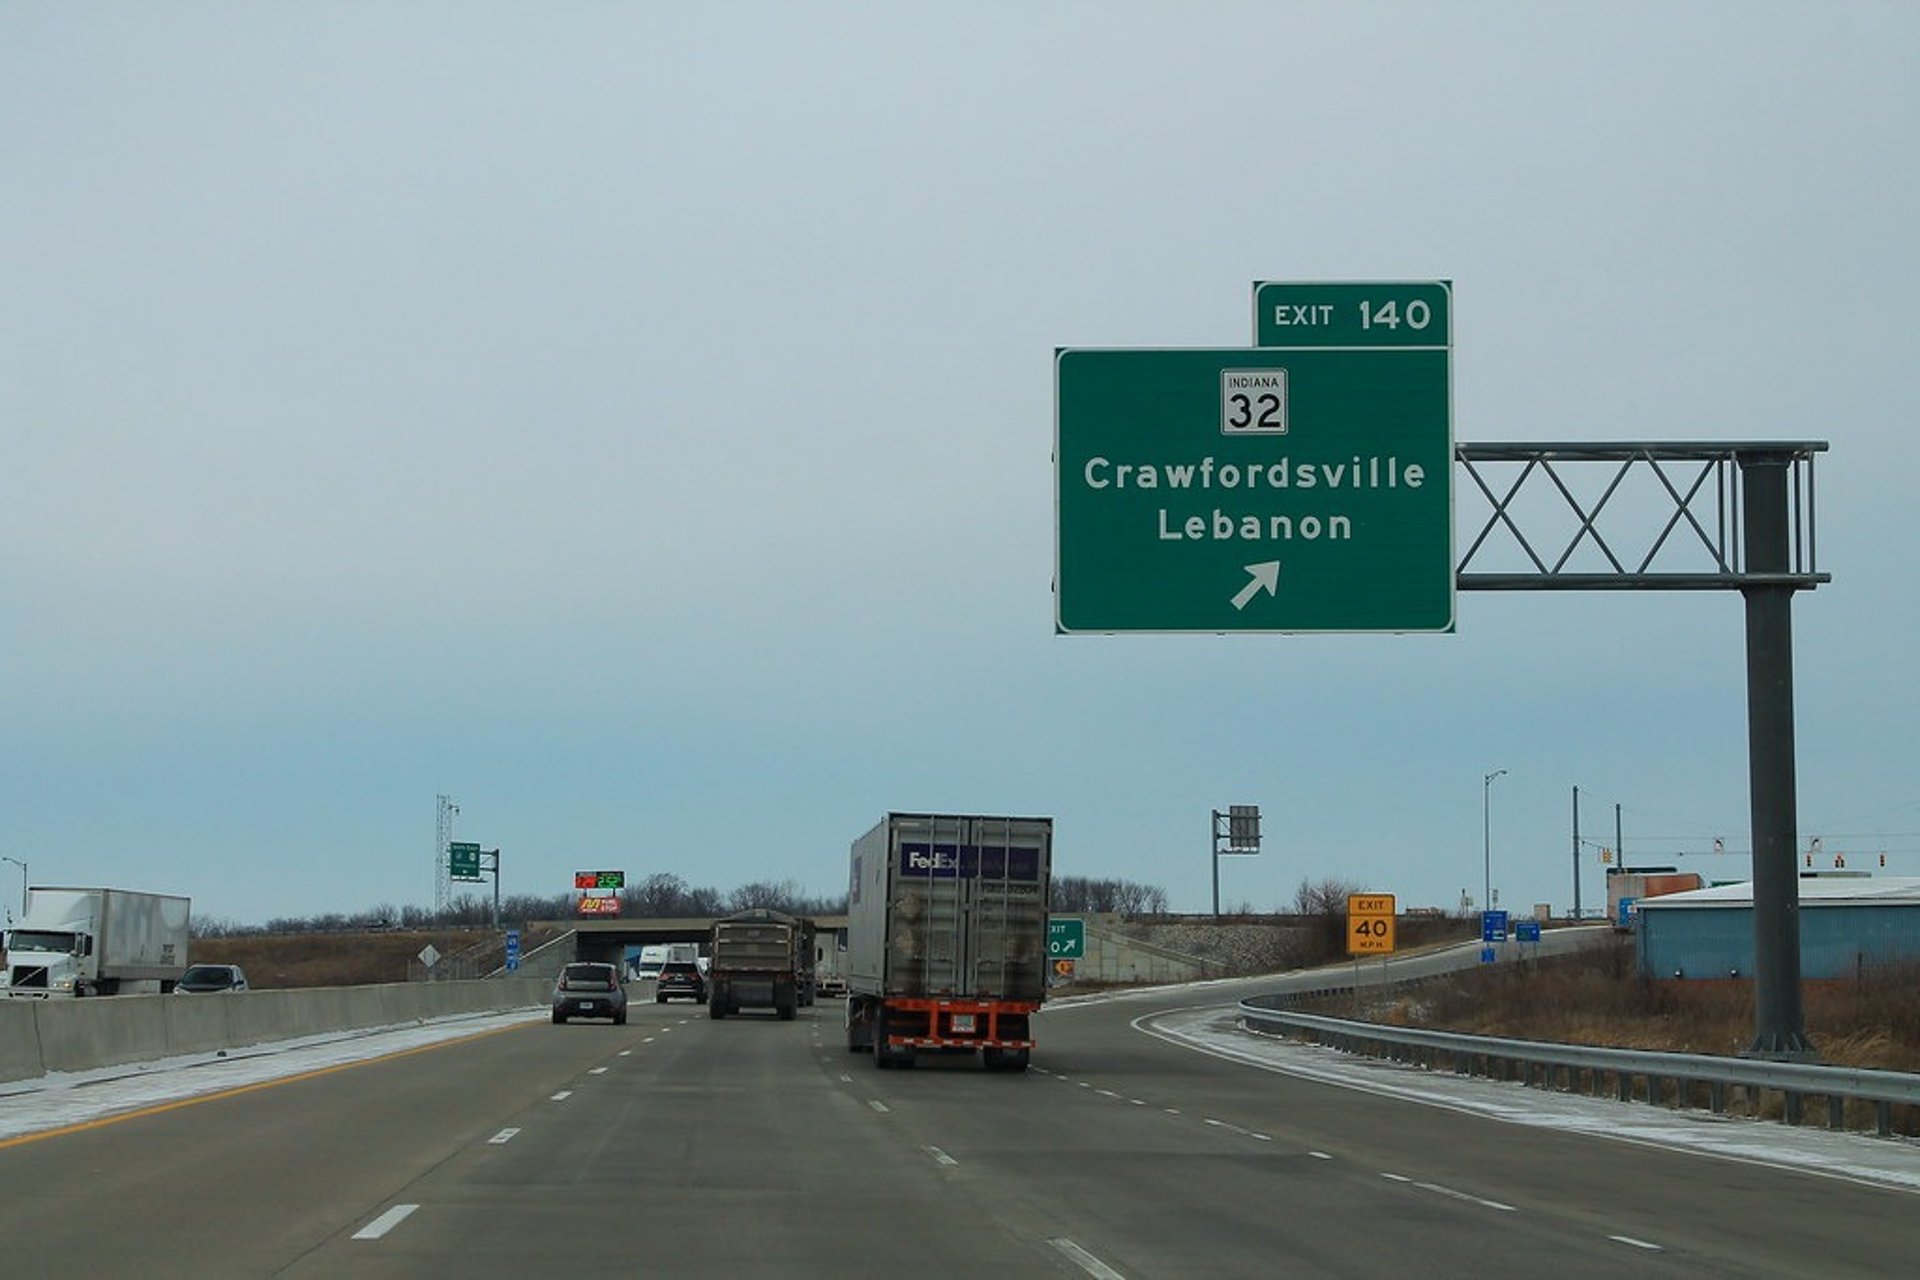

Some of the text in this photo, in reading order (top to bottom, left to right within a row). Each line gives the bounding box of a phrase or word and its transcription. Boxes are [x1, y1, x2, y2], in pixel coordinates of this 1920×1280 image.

[1274, 300, 1433, 330] EXIT 140
[1228, 376, 1280, 389] INDIANA
[1228, 393, 1282, 430] 32
[1083, 456, 1426, 490] Crawfordsville
[1158, 508, 1352, 541] Lebanon
[908, 851, 957, 870] FedEx
[1358, 900, 1384, 910] EXIT
[1355, 919, 1387, 938] 40
